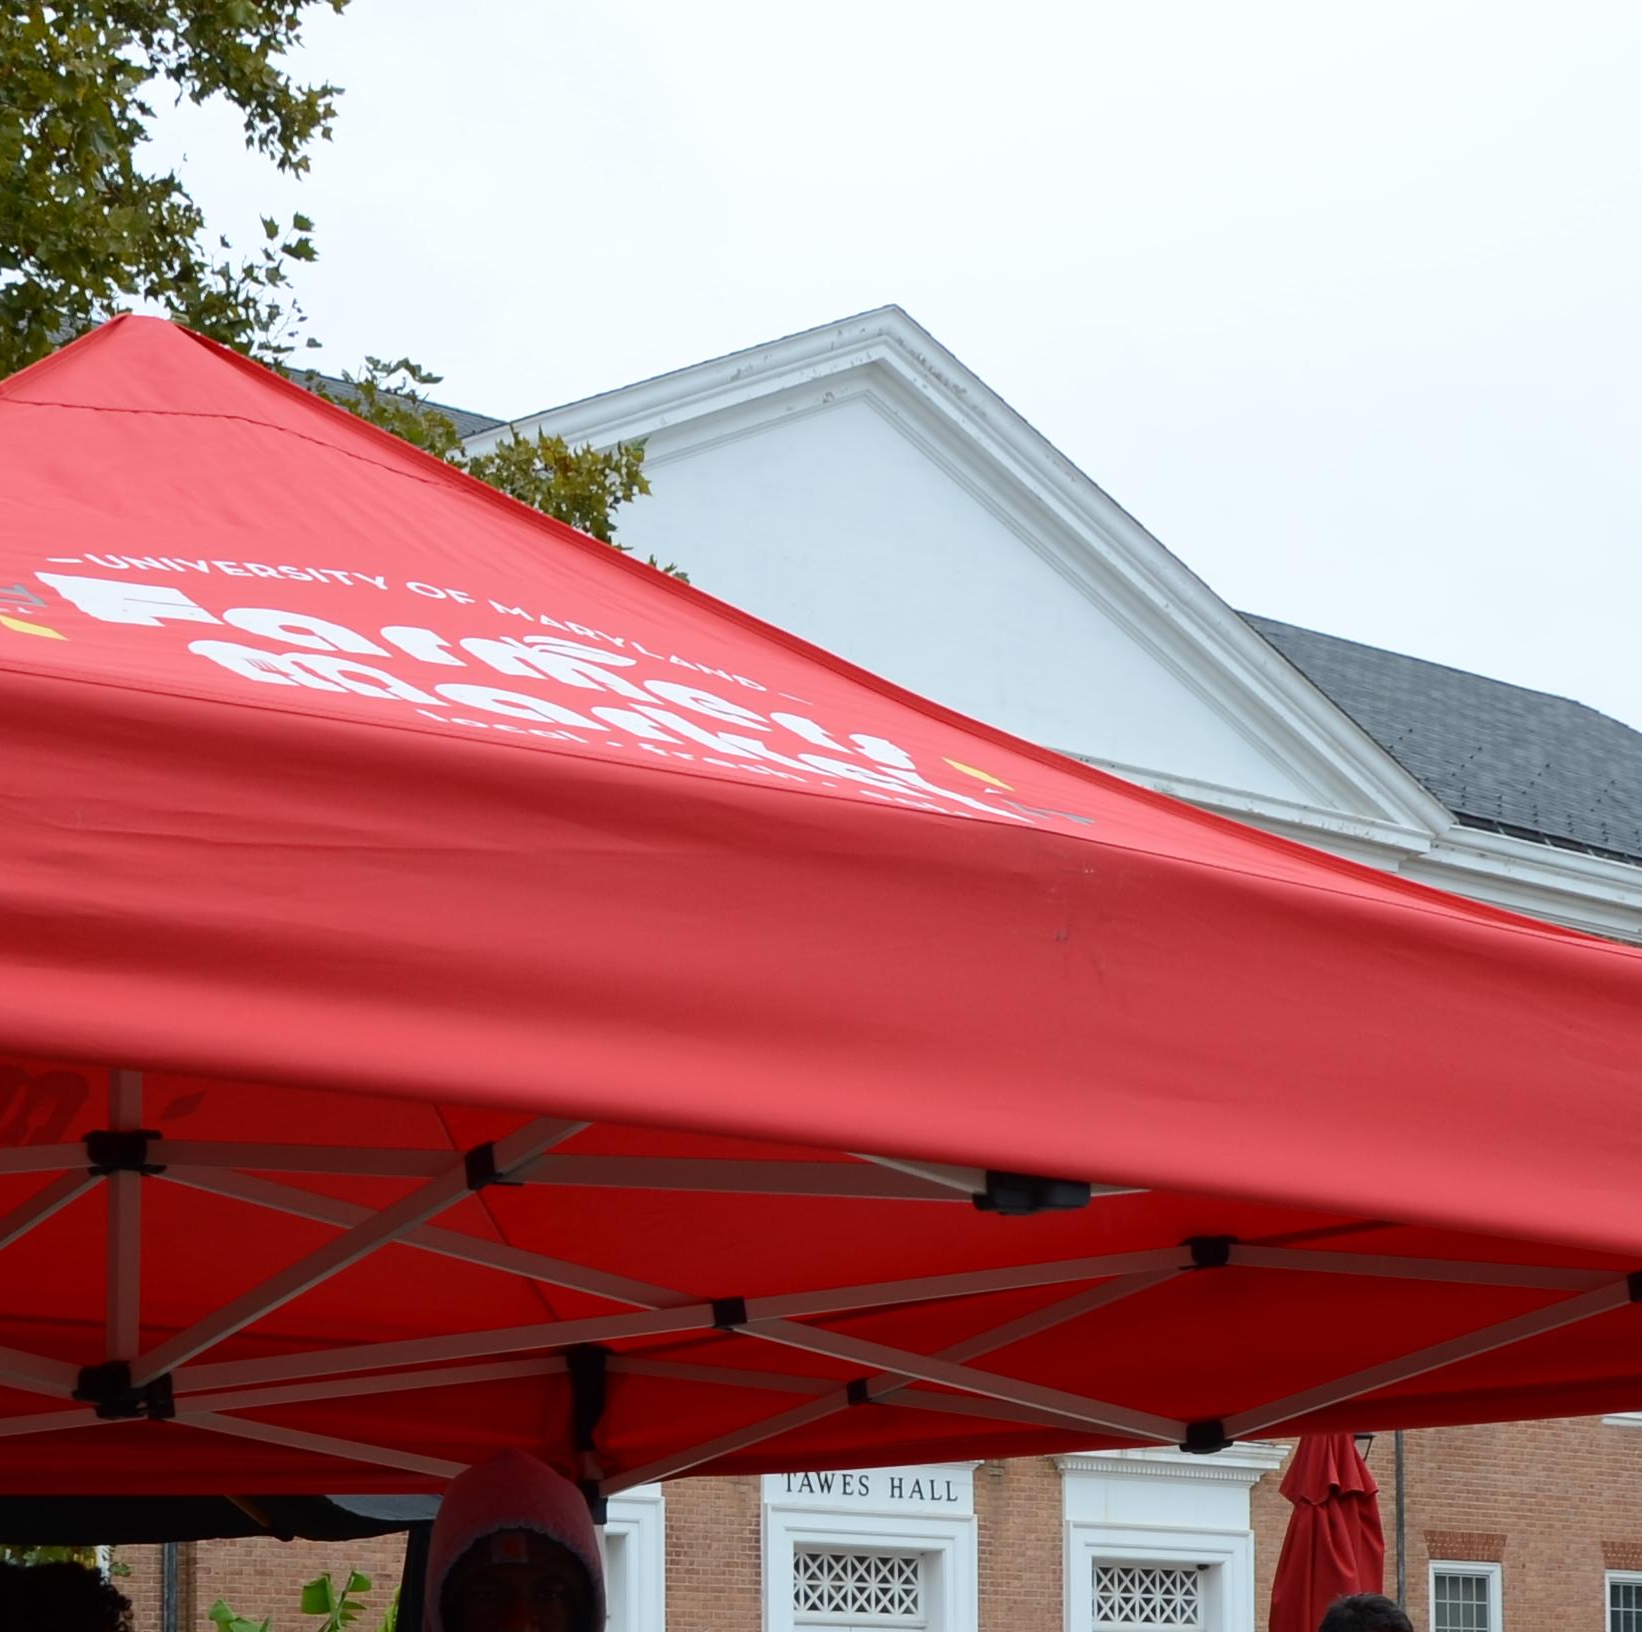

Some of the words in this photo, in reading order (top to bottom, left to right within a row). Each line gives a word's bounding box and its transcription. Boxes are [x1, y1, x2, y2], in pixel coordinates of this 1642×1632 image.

[34, 572, 917, 770] Farmers
[84, 553, 388, 587] UNIVERSITY
[406, 581, 476, 604] OF
[488, 600, 768, 692] MARYLAND
[188, 640, 1035, 823] Market
[781, 1472, 870, 1496] TAWES
[889, 1477, 959, 1502] HALL
